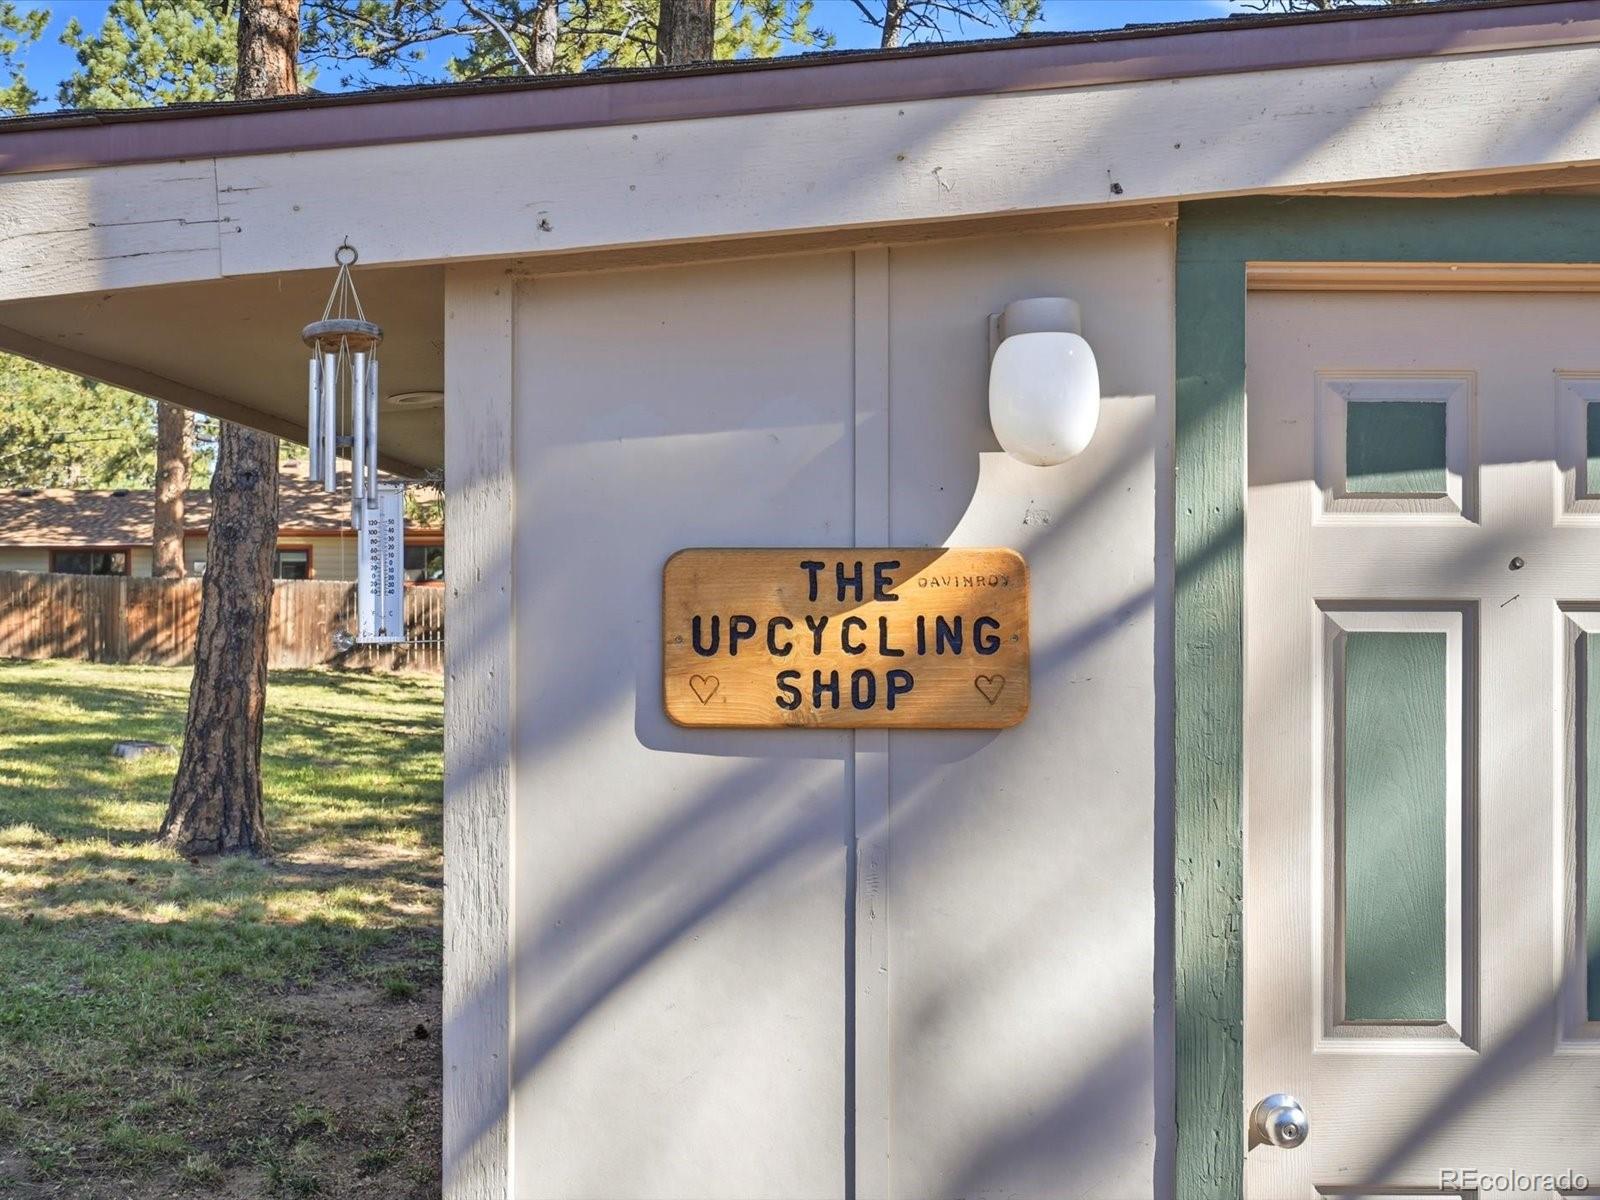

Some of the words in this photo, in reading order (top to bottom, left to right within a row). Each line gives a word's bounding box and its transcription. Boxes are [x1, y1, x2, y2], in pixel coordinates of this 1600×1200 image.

[801, 561, 900, 602] THE
[692, 615, 1001, 656] UPCYCLING
[776, 669, 914, 711] SHOP
